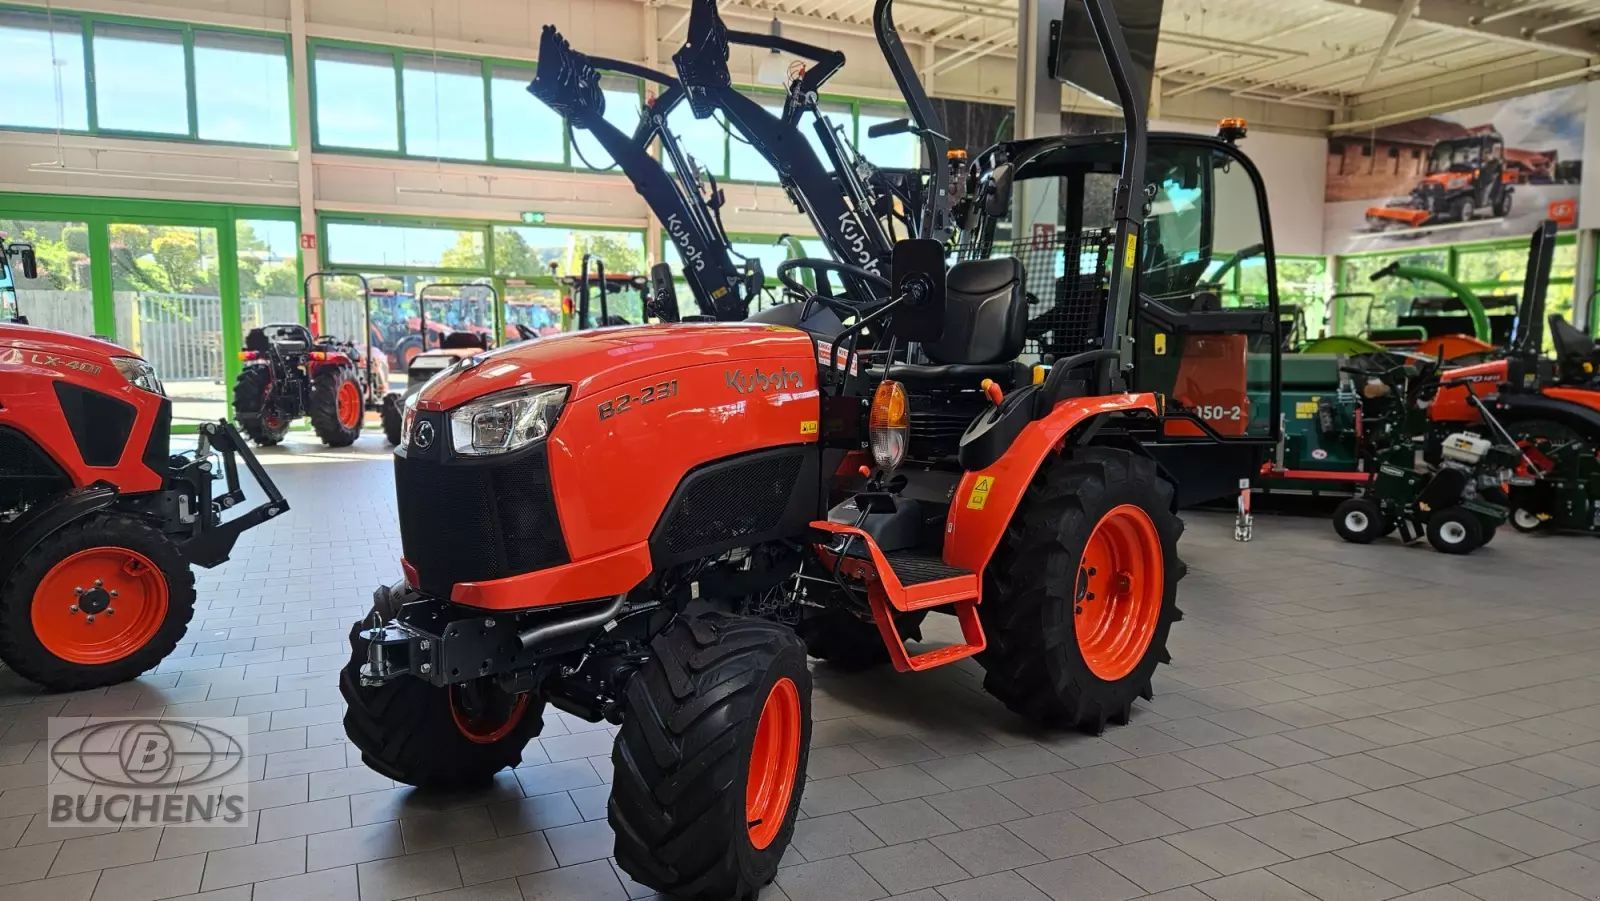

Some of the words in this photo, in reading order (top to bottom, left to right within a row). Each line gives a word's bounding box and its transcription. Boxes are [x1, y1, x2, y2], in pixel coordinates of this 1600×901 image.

[667, 212, 705, 271] Kubota
[597, 379, 679, 422] B2-231
[724, 366, 804, 394] Kubota
